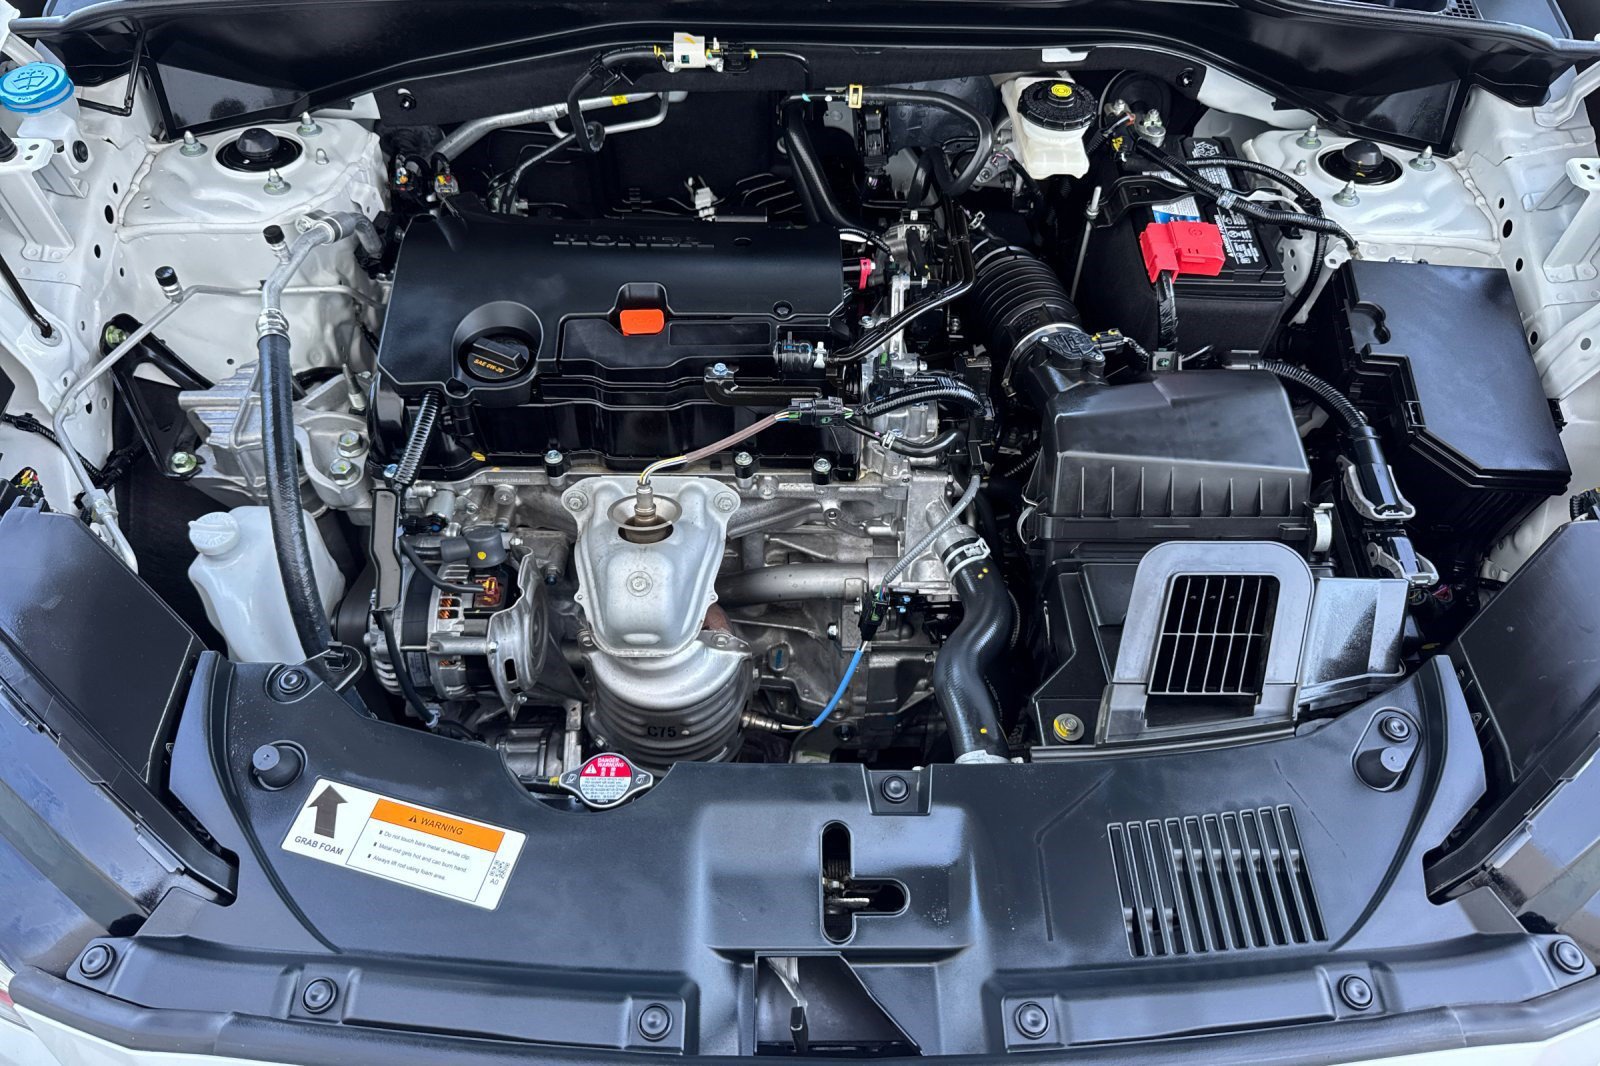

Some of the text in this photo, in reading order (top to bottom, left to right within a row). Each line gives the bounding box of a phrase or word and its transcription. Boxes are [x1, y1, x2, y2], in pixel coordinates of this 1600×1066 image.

[473, 359, 487, 367] SAE
[421, 817, 463, 835] WARNING
[294, 835, 344, 855] GRAB FOAM
[379, 843, 392, 851] Metal
[427, 843, 440, 851] metal
[447, 849, 460, 857] white
[373, 855, 390, 865] Always
[406, 865, 420, 873] using
[420, 868, 433, 877] foam
